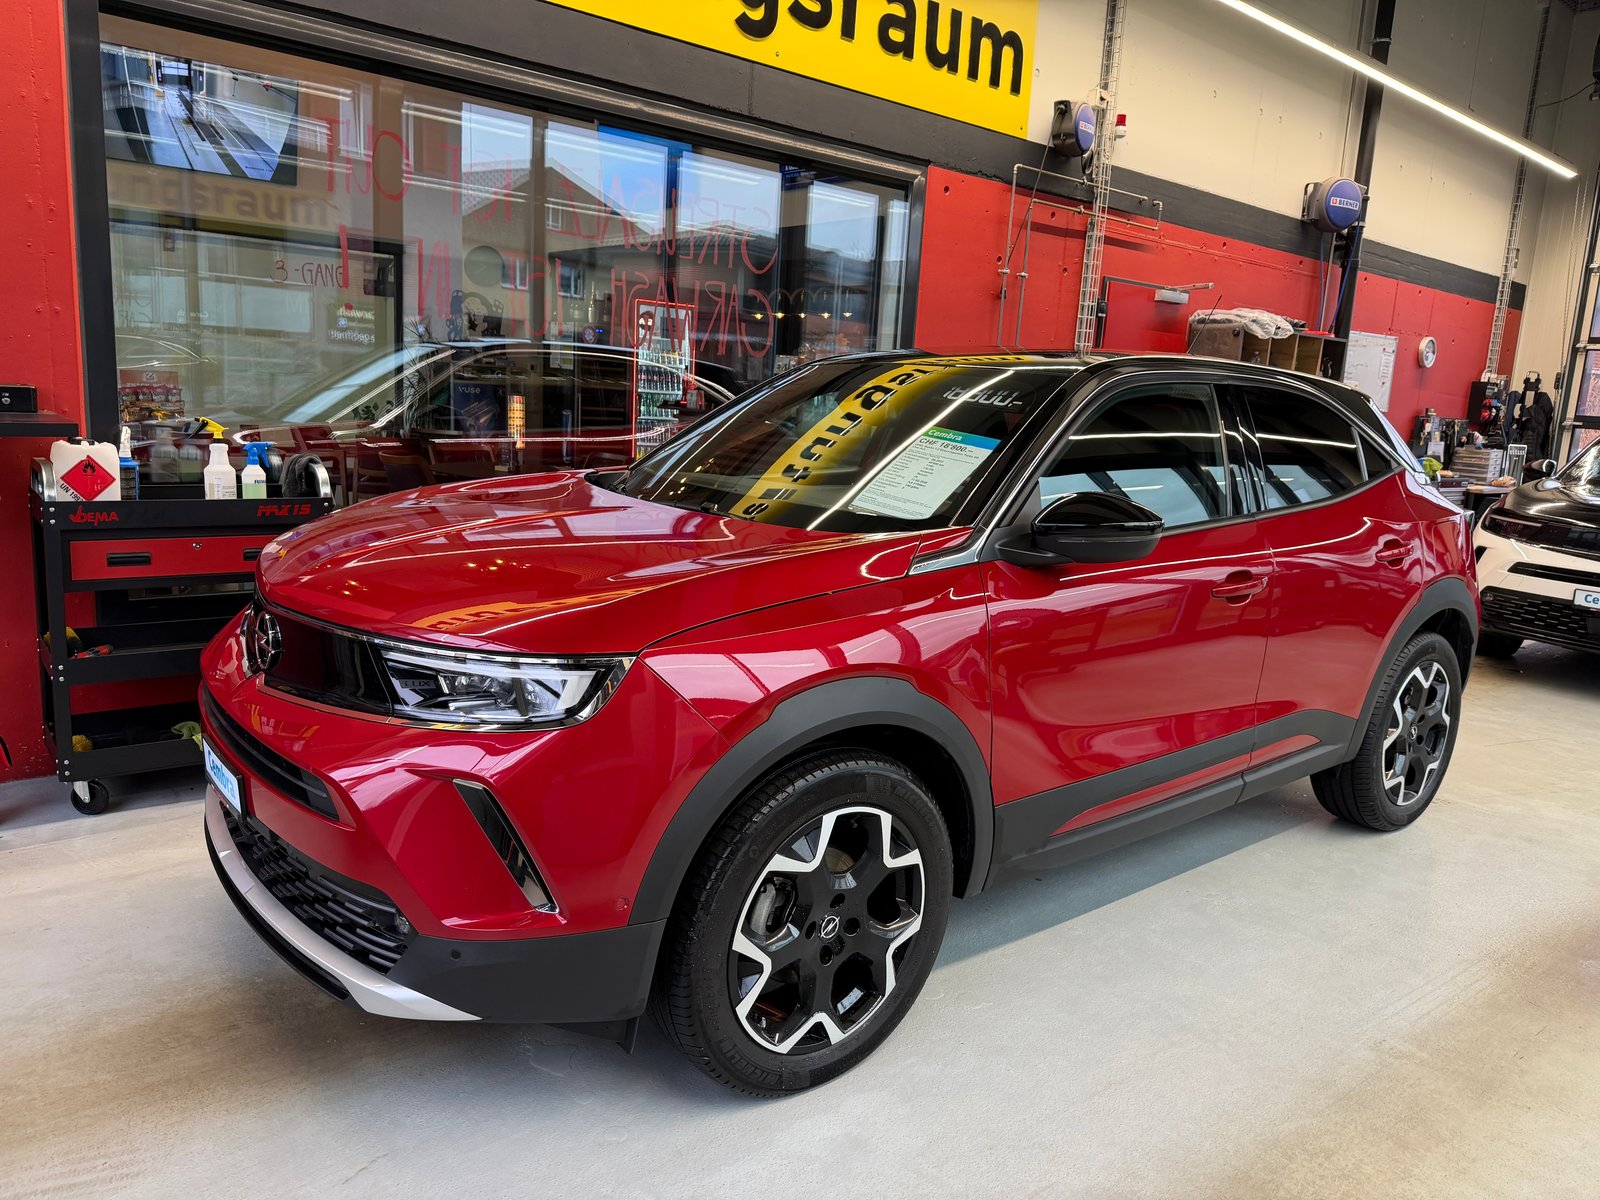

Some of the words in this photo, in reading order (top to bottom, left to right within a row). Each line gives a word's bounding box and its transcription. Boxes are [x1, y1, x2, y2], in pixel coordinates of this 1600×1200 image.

[1338, 199, 1359, 209] BERNER
[928, 429, 963, 441] Cembra
[919, 437, 938, 447] CHF
[60, 483, 71, 494] UN
